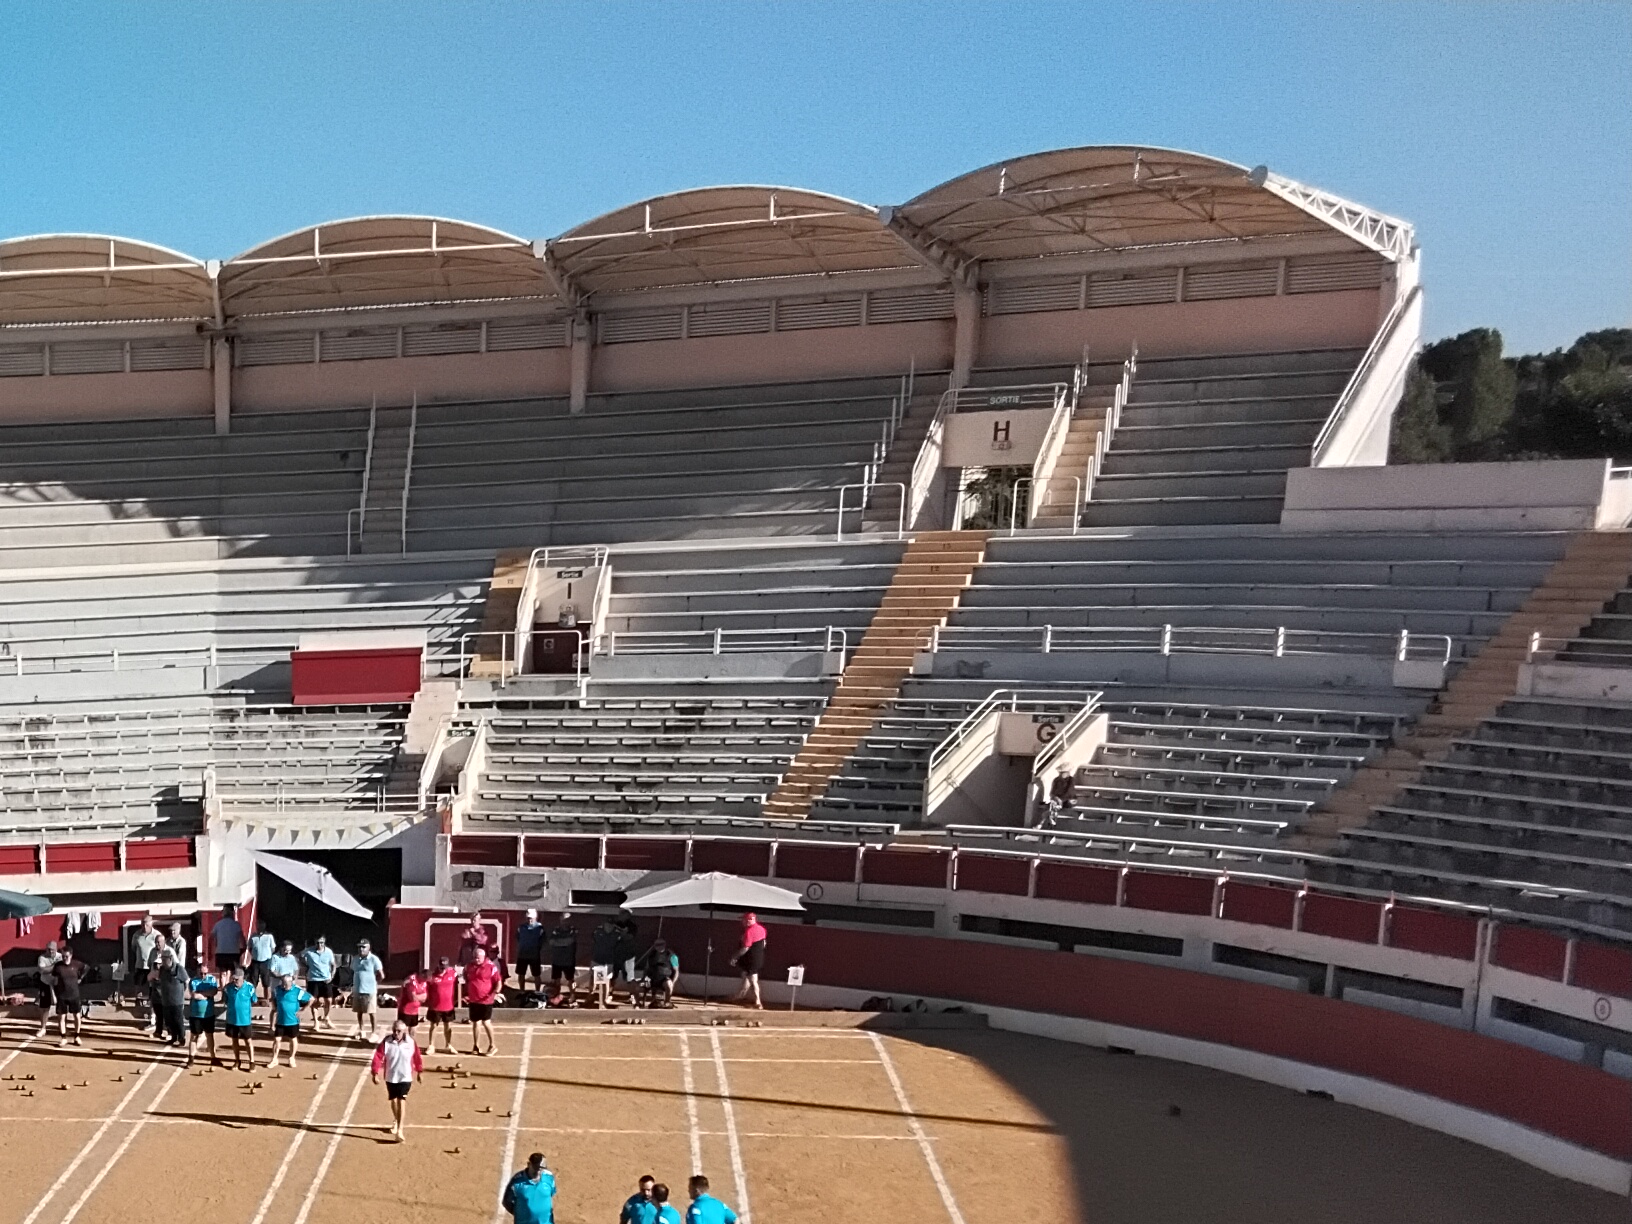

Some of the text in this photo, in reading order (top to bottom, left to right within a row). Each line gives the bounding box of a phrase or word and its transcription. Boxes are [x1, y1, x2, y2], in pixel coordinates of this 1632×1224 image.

[989, 395, 1021, 405] SORTIE
[993, 420, 1010, 441] H
[1036, 722, 1057, 743] G
